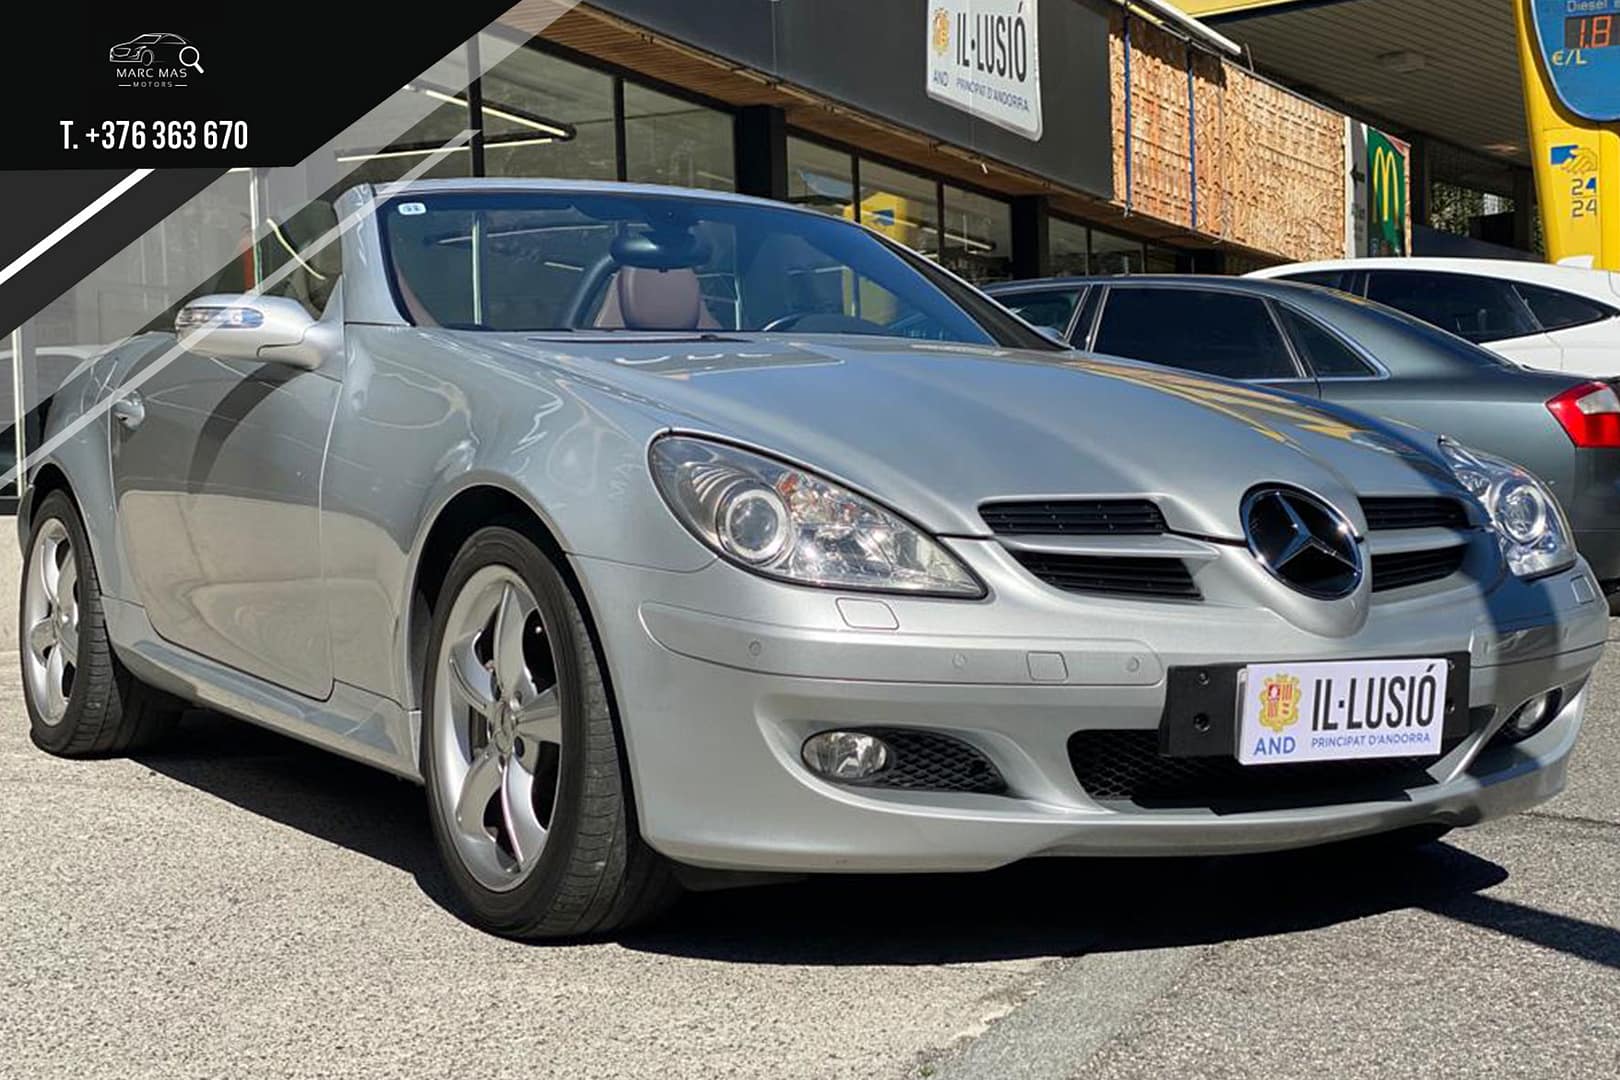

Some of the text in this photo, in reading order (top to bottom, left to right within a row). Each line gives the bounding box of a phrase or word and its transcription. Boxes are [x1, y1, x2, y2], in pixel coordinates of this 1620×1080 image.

[1567, 0, 1608, 12] Diesel
[932, 70, 949, 88] AND
[1571, 198, 1597, 218] 24
[1253, 736, 1297, 756] AND
[1311, 732, 1431, 749] PRINCIPAT D'ANDORRA
